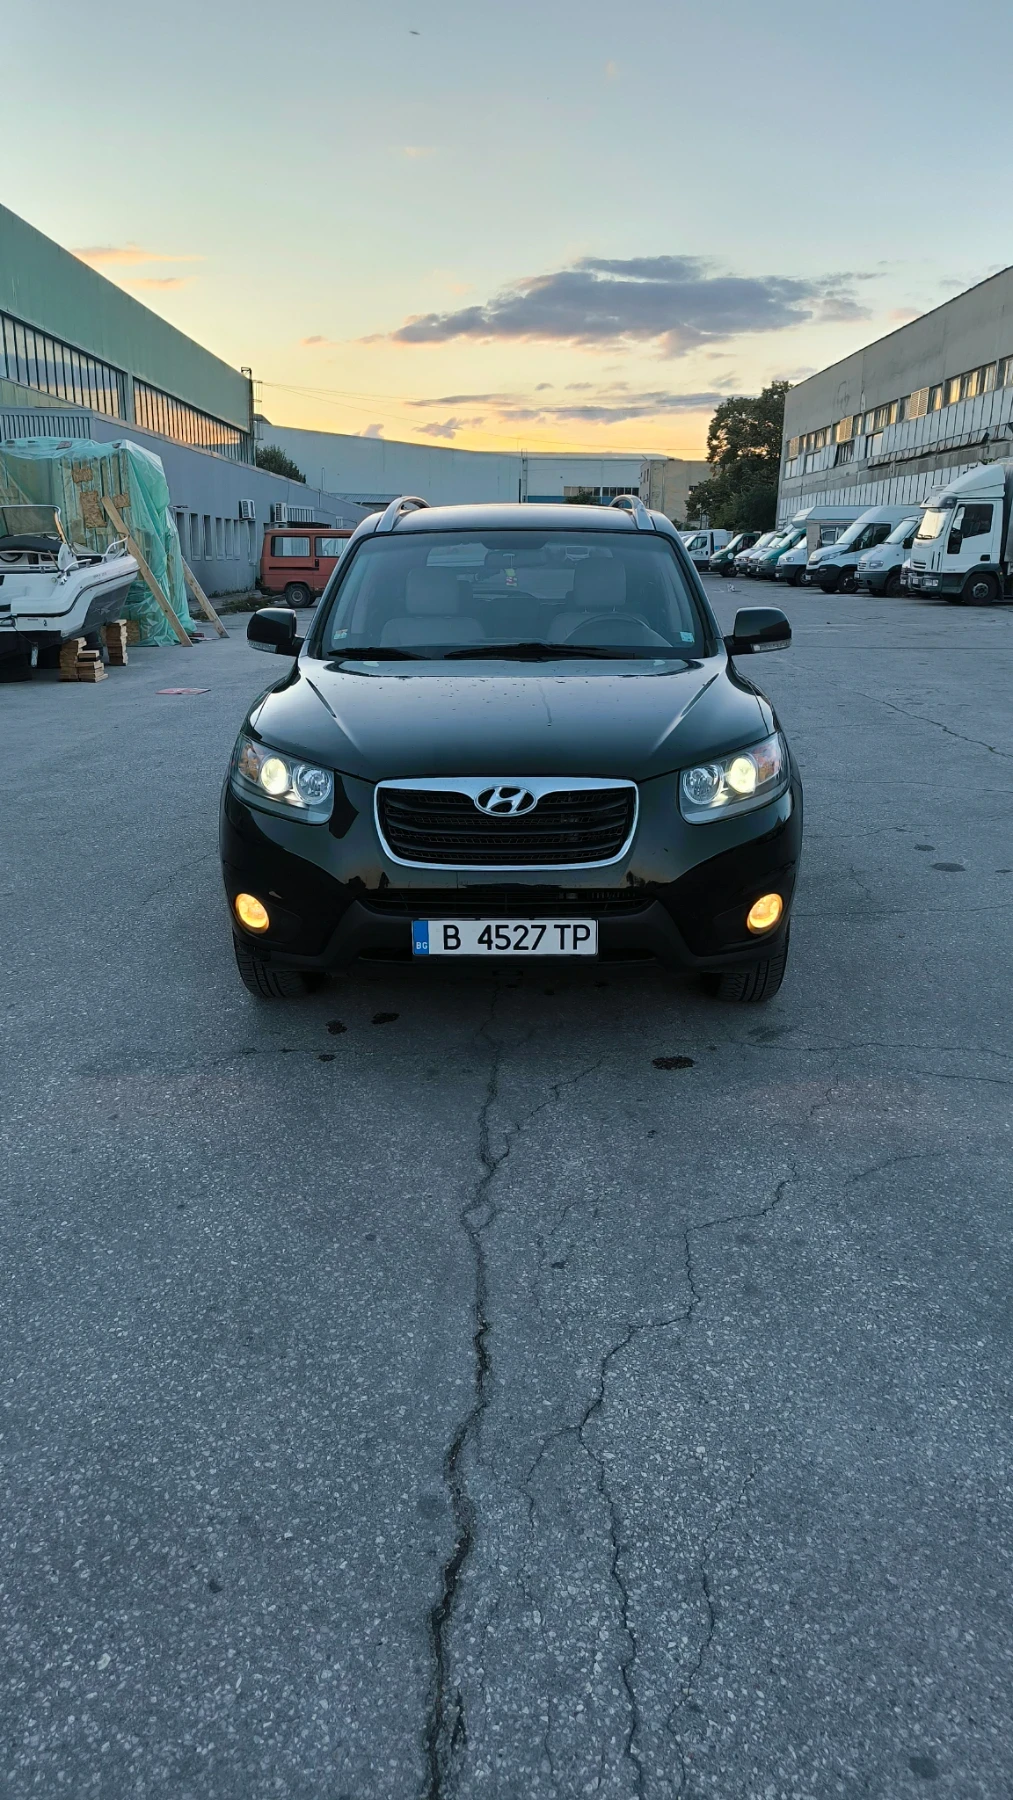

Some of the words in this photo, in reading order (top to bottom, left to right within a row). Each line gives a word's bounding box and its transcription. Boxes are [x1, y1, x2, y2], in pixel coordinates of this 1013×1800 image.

[416, 941, 428, 950] BG
[443, 924, 461, 950] B
[477, 924, 547, 951] 4527
[553, 924, 591, 950] TP
